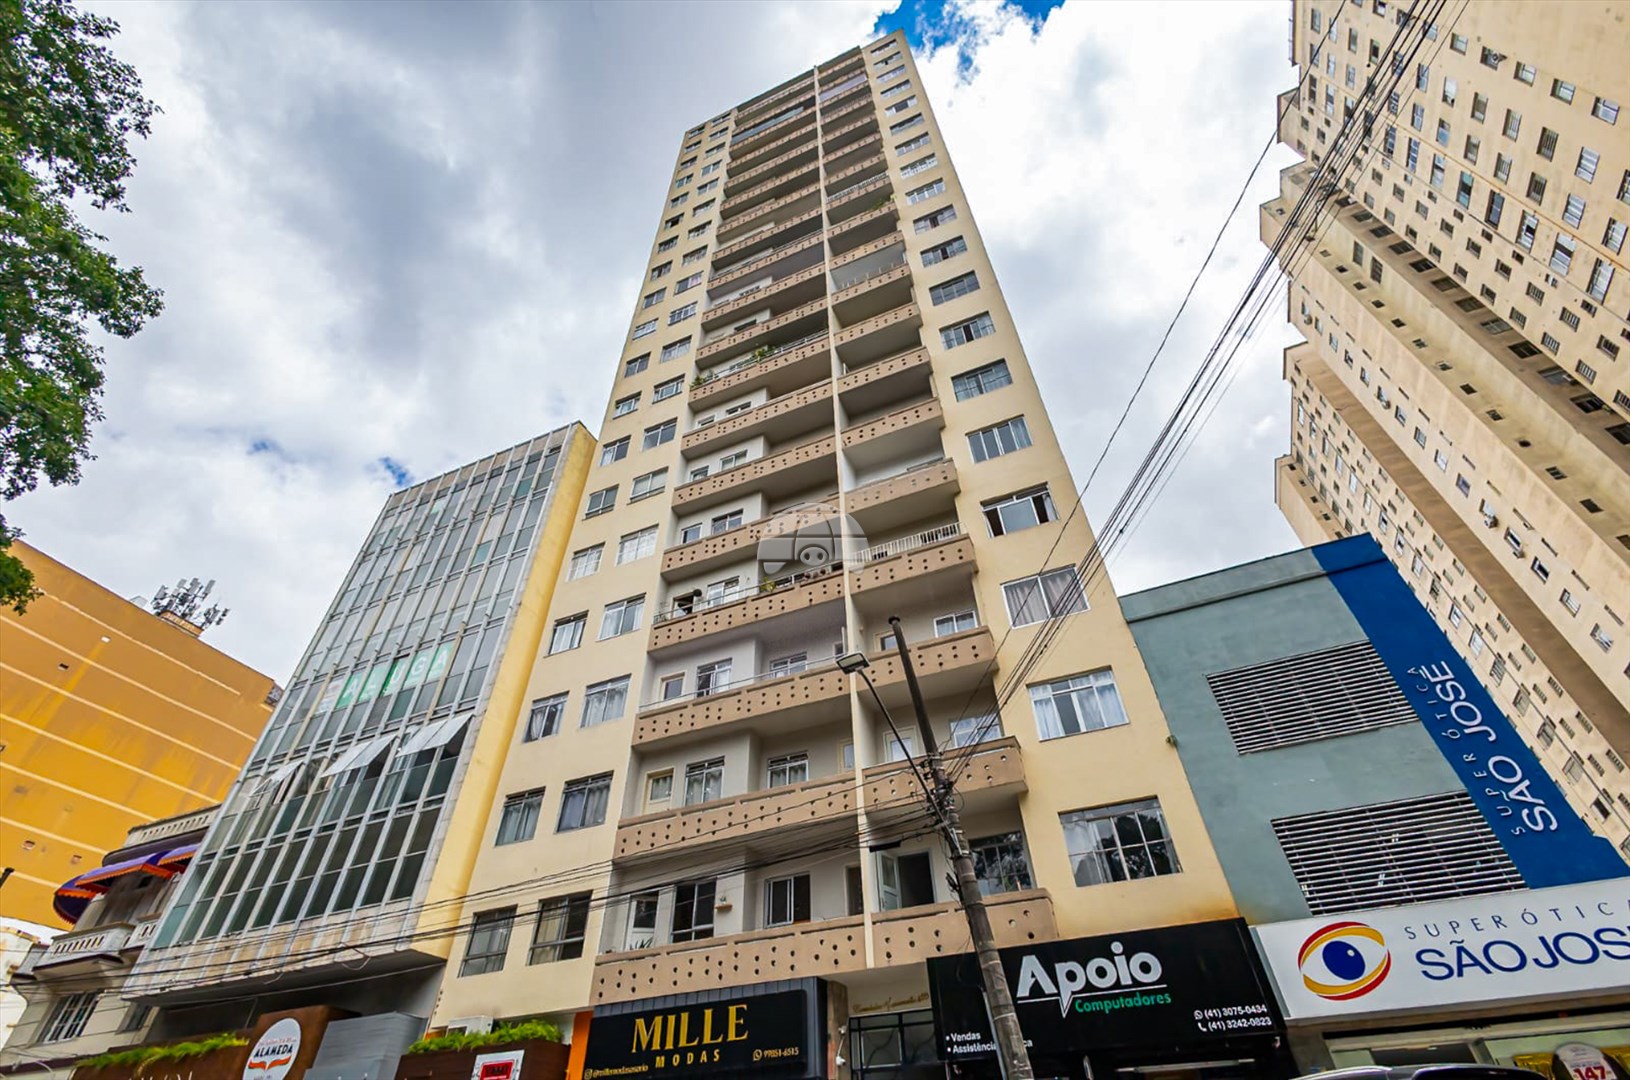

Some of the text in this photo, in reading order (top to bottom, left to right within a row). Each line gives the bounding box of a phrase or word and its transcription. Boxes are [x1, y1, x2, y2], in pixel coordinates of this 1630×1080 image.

[1488, 755, 1558, 832] SÃO
[1415, 926, 1630, 981] SÃO JOS
[1016, 941, 1163, 1018] Apoio
[1075, 991, 1171, 1014] Computadores
[1204, 1004, 1267, 1020] (41) 3075-0434
[631, 1003, 749, 1053] MILLE
[1208, 1016, 1272, 1032] (41) 3242-0823
[950, 1031, 981, 1042] Vendas
[253, 1044, 294, 1058] ALAMEDA
[655, 1049, 720, 1069] MODAS
